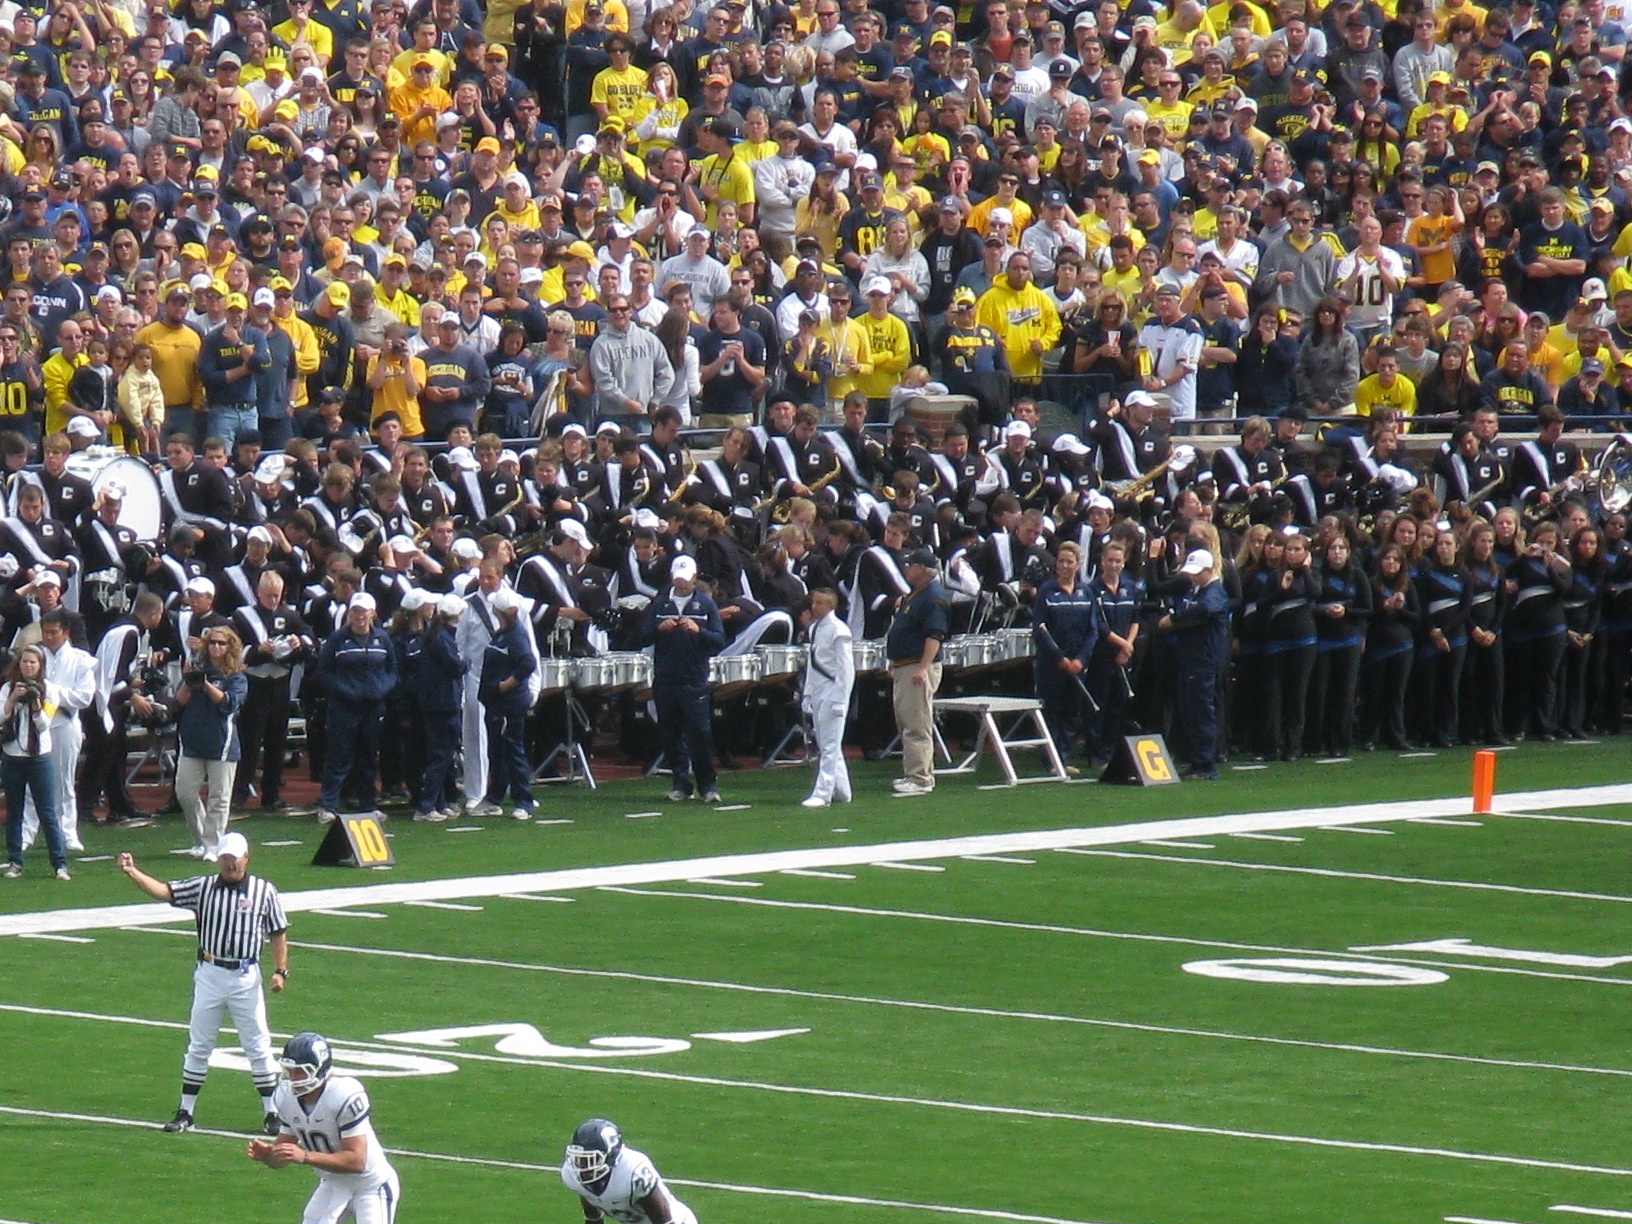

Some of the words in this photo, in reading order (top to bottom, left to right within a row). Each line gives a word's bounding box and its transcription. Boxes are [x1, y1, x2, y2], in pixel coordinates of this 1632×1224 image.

[1355, 274, 1385, 307] 10
[1589, 284, 1599, 292] M
[1031, 318, 1042, 328] M
[1144, 441, 1154, 452] C
[809, 453, 820, 465] C
[1556, 452, 1566, 464] C
[1257, 462, 1268, 473] C
[1480, 466, 1490, 478] C
[188, 474, 199, 485] C
[578, 470, 588, 481] C
[739, 473, 749, 485] C
[1021, 471, 1032, 482] C
[62, 487, 74, 499] C
[495, 483, 507, 495] C
[422, 499, 433, 511] C
[911, 515, 922, 527] C
[42, 524, 54, 536] C
[118, 531, 130, 542] C
[274, 617, 285, 629] C
[1136, 740, 1171, 782] G
[347, 818, 389, 863] 10
[346, 1095, 366, 1117] 10
[632, 1167, 657, 1196] 23
